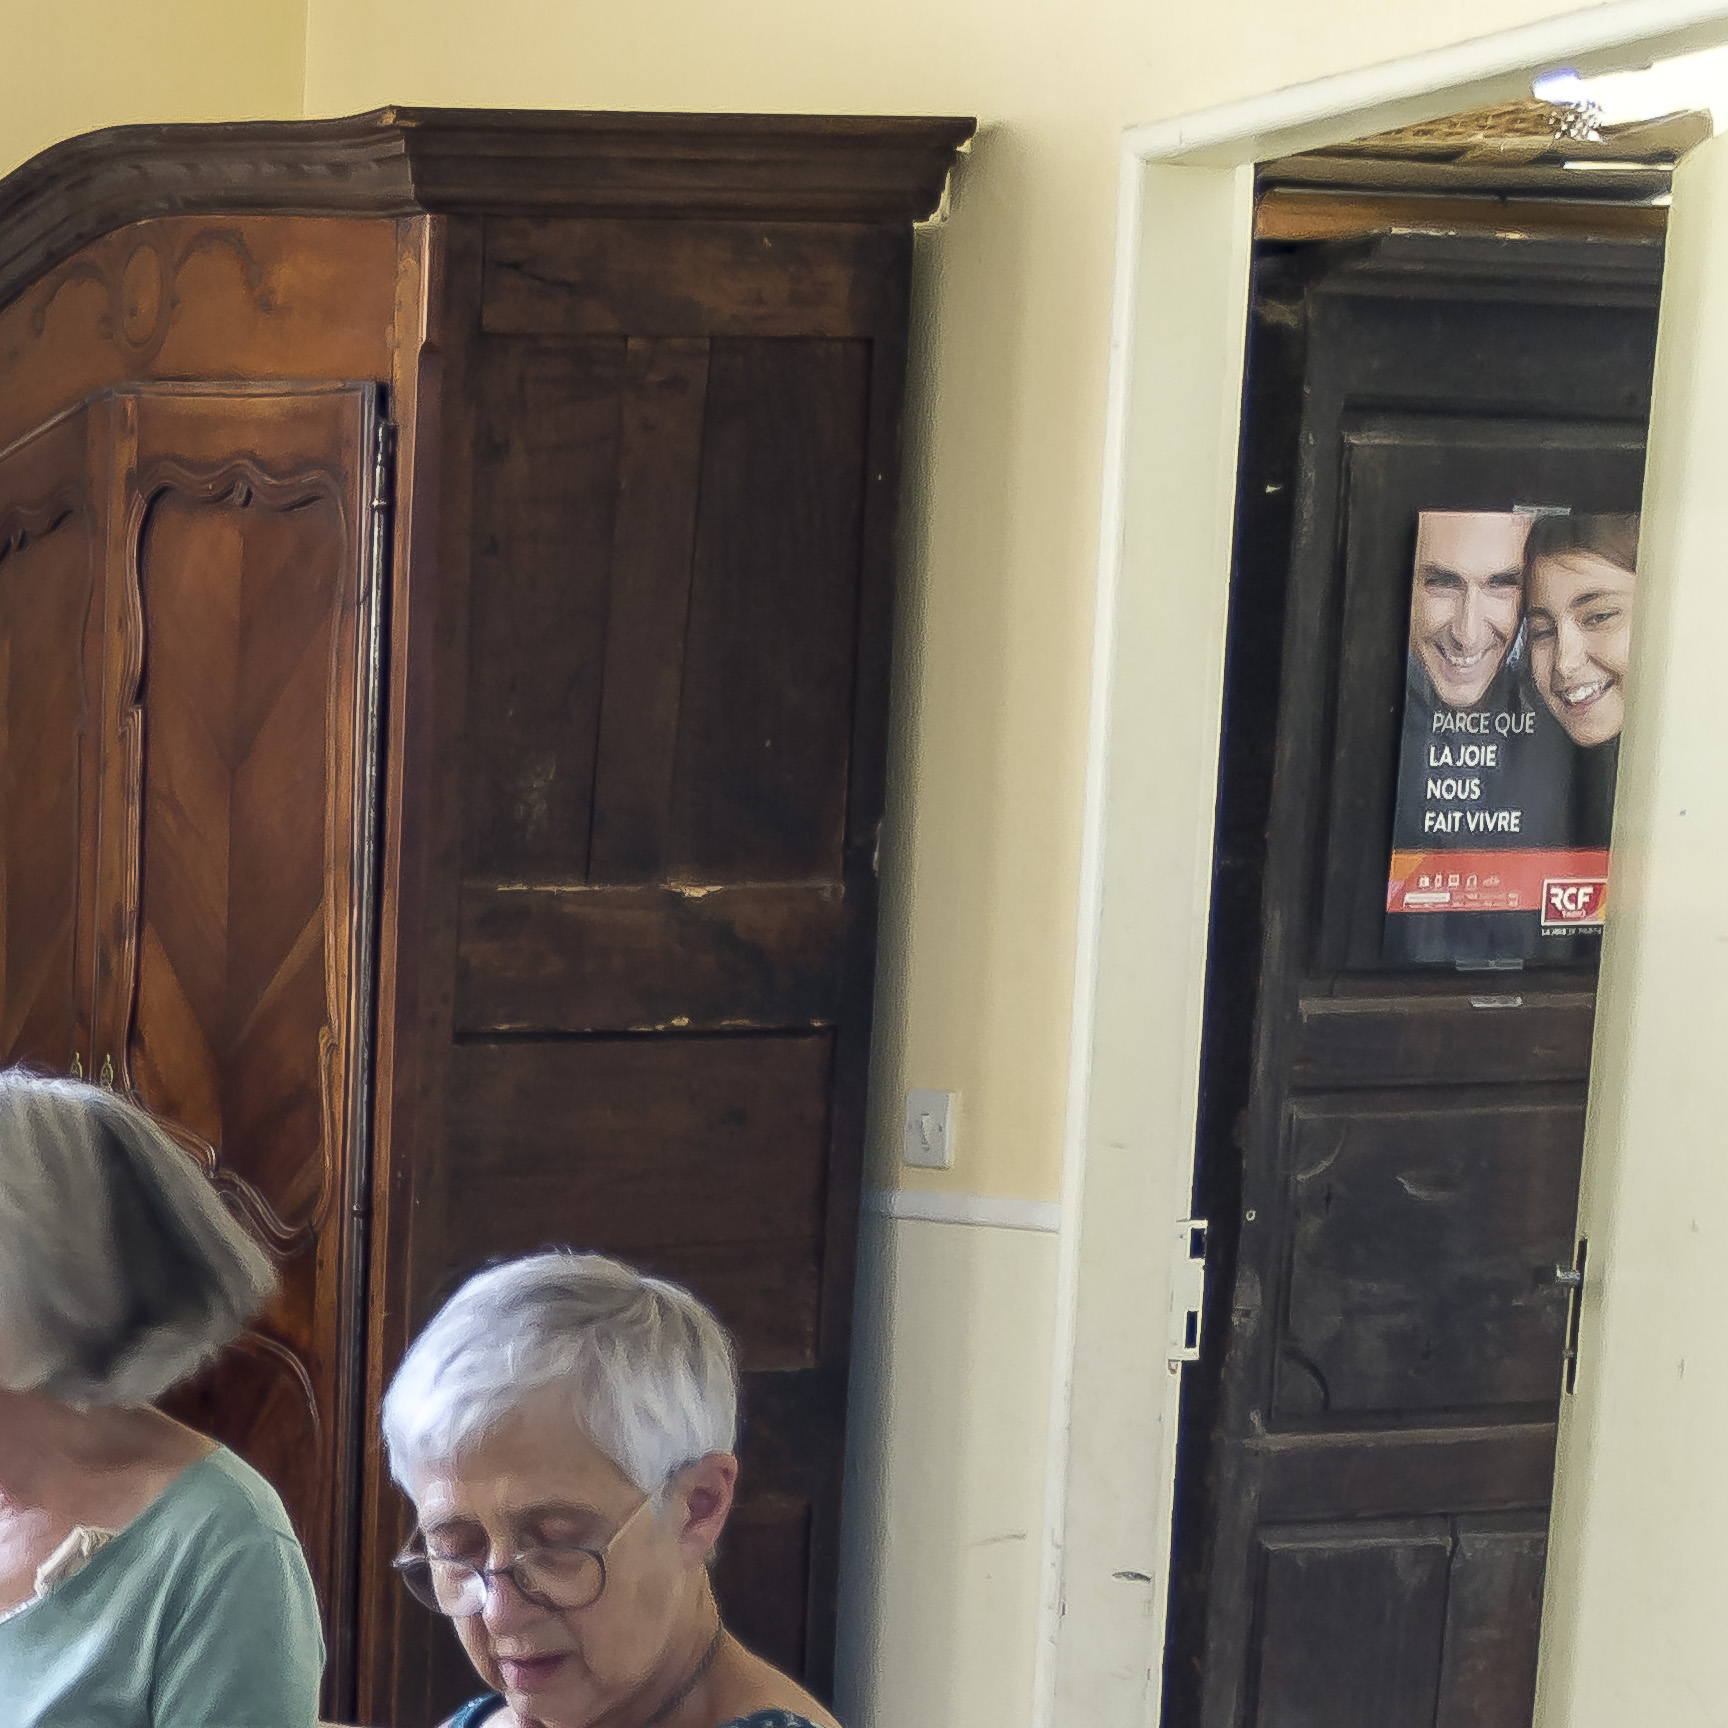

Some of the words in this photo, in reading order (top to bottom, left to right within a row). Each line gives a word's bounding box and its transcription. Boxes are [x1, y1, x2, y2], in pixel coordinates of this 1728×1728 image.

[1432, 710, 1491, 734] PARCE
[1494, 710, 1536, 738] QUE
[1429, 744, 1453, 767] LA
[1455, 743, 1498, 768] JOIE
[1426, 778, 1481, 800] NOUS
[1424, 810, 1464, 833] FAIT
[1466, 810, 1522, 833] VIVRE
[1549, 886, 1594, 911] RCF
